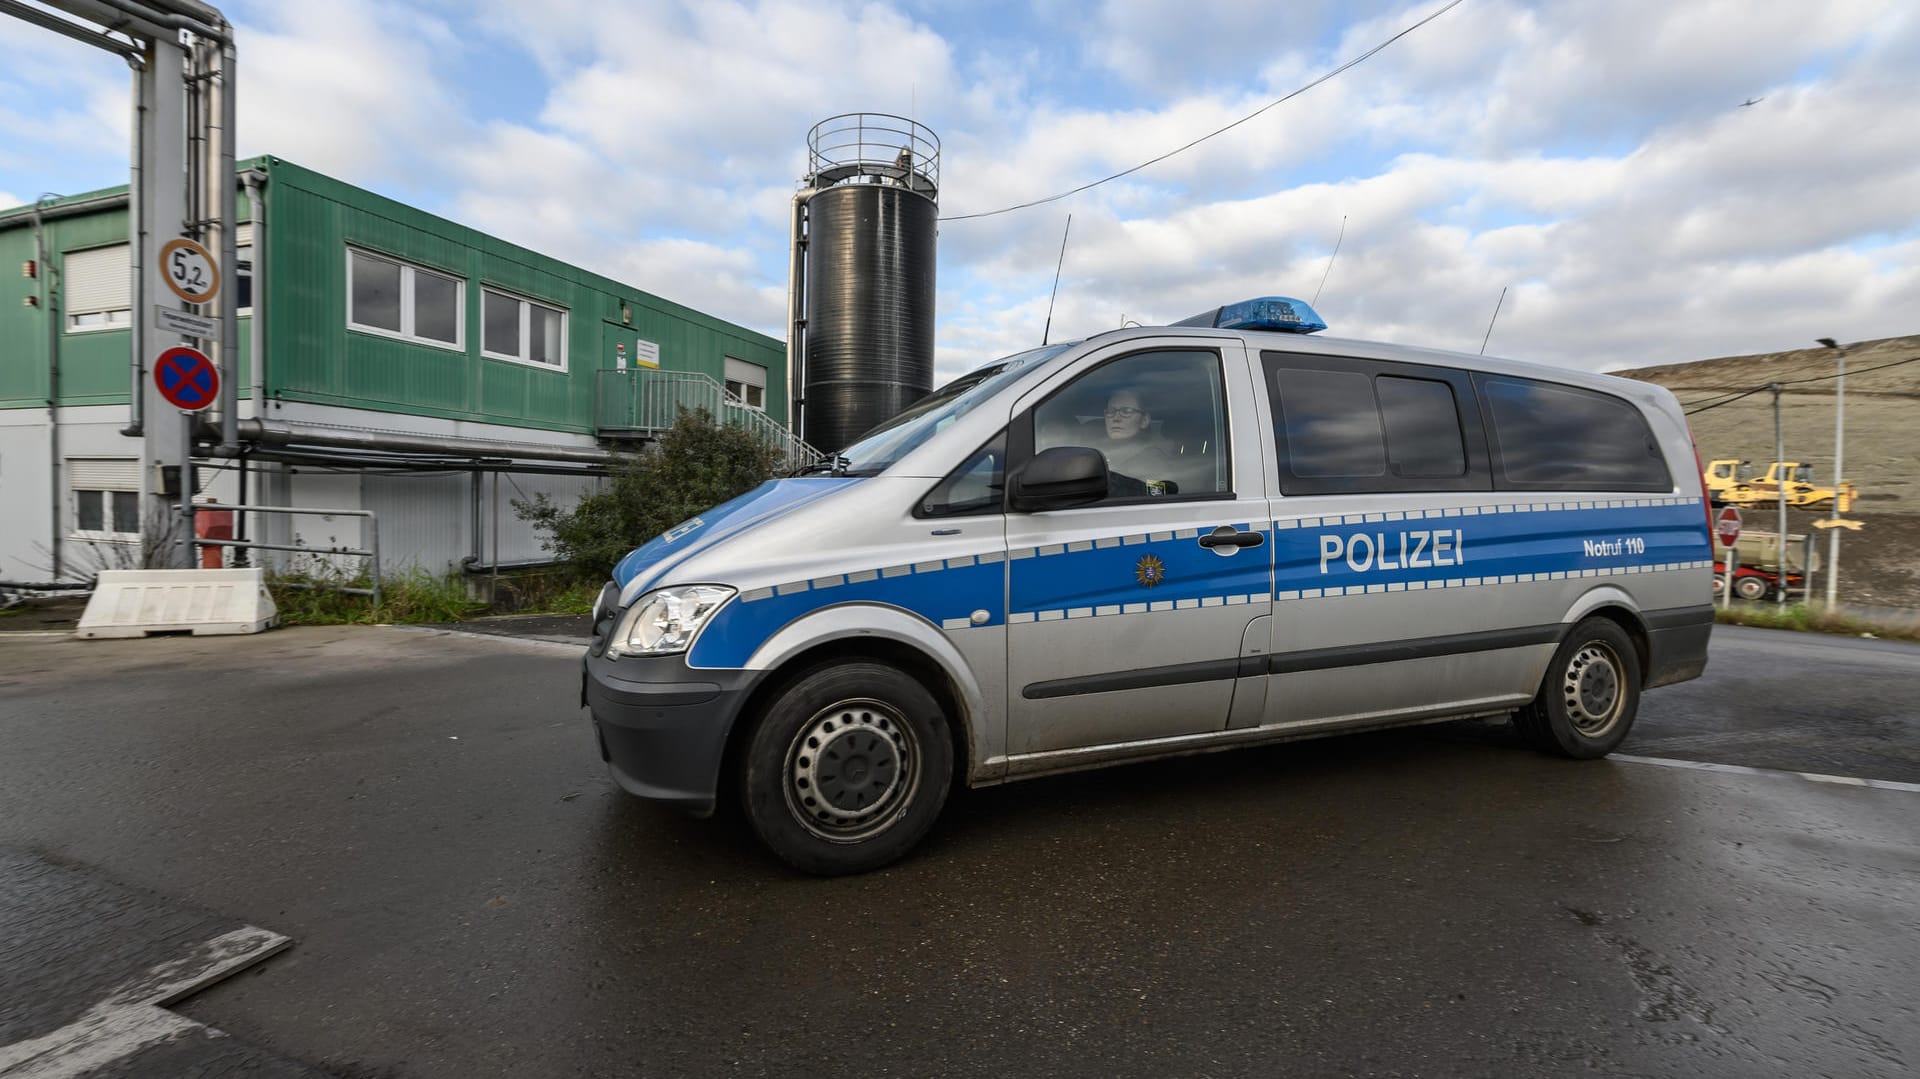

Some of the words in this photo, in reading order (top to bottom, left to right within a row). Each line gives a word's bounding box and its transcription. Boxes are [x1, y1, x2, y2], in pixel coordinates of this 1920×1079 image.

[1320, 529, 1464, 574] POLIZEI
[1583, 538, 1622, 557] Notruf
[1625, 537, 1645, 555] 110
